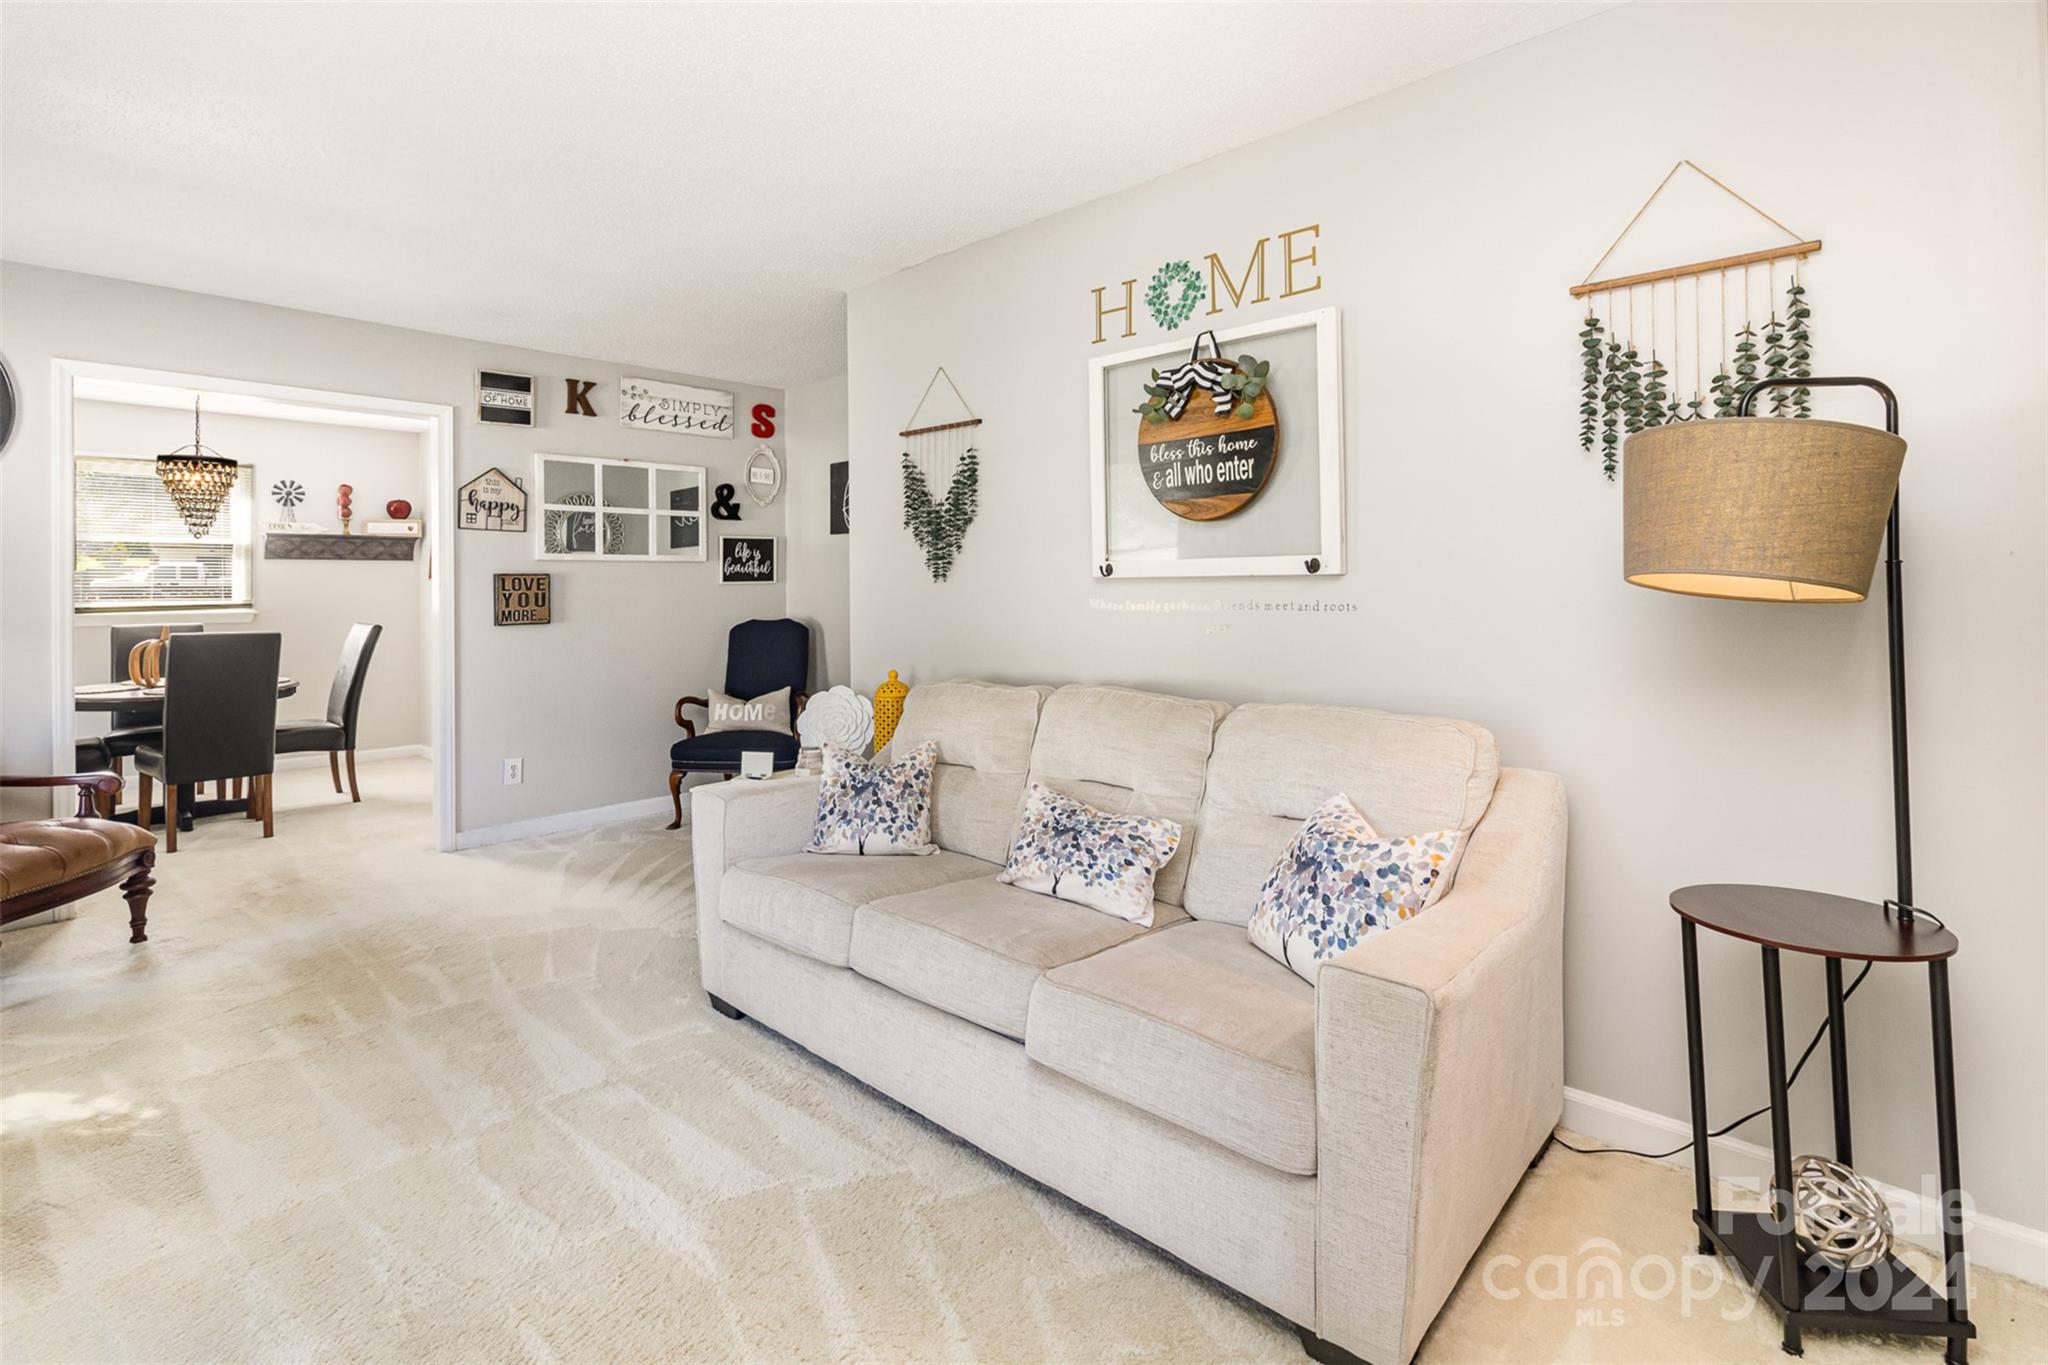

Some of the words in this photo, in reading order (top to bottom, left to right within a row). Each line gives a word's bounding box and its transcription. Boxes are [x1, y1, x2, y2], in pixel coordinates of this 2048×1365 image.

[483, 395, 497, 403] OF
[501, 397, 528, 407] HOME
[565, 378, 597, 417] K
[658, 398, 721, 417] SIMPLY
[621, 402, 734, 432] blessed
[751, 403, 776, 439] S
[1150, 444, 1185, 463] bless
[1186, 438, 1214, 458] this
[1218, 435, 1257, 454] home
[1152, 471, 1165, 490] &
[1165, 462, 1182, 488] all
[1184, 459, 1213, 486] who
[1216, 455, 1255, 482] enter
[468, 488, 520, 522] happy
[710, 483, 742, 521] &
[734, 541, 752, 562] life
[724, 556, 771, 577] beautiful
[501, 577, 546, 591] LOVE
[502, 592, 546, 608] YOU
[1264, 601, 1295, 611] meet
[1298, 600, 1319, 612] and
[1324, 602, 1358, 612] roots
